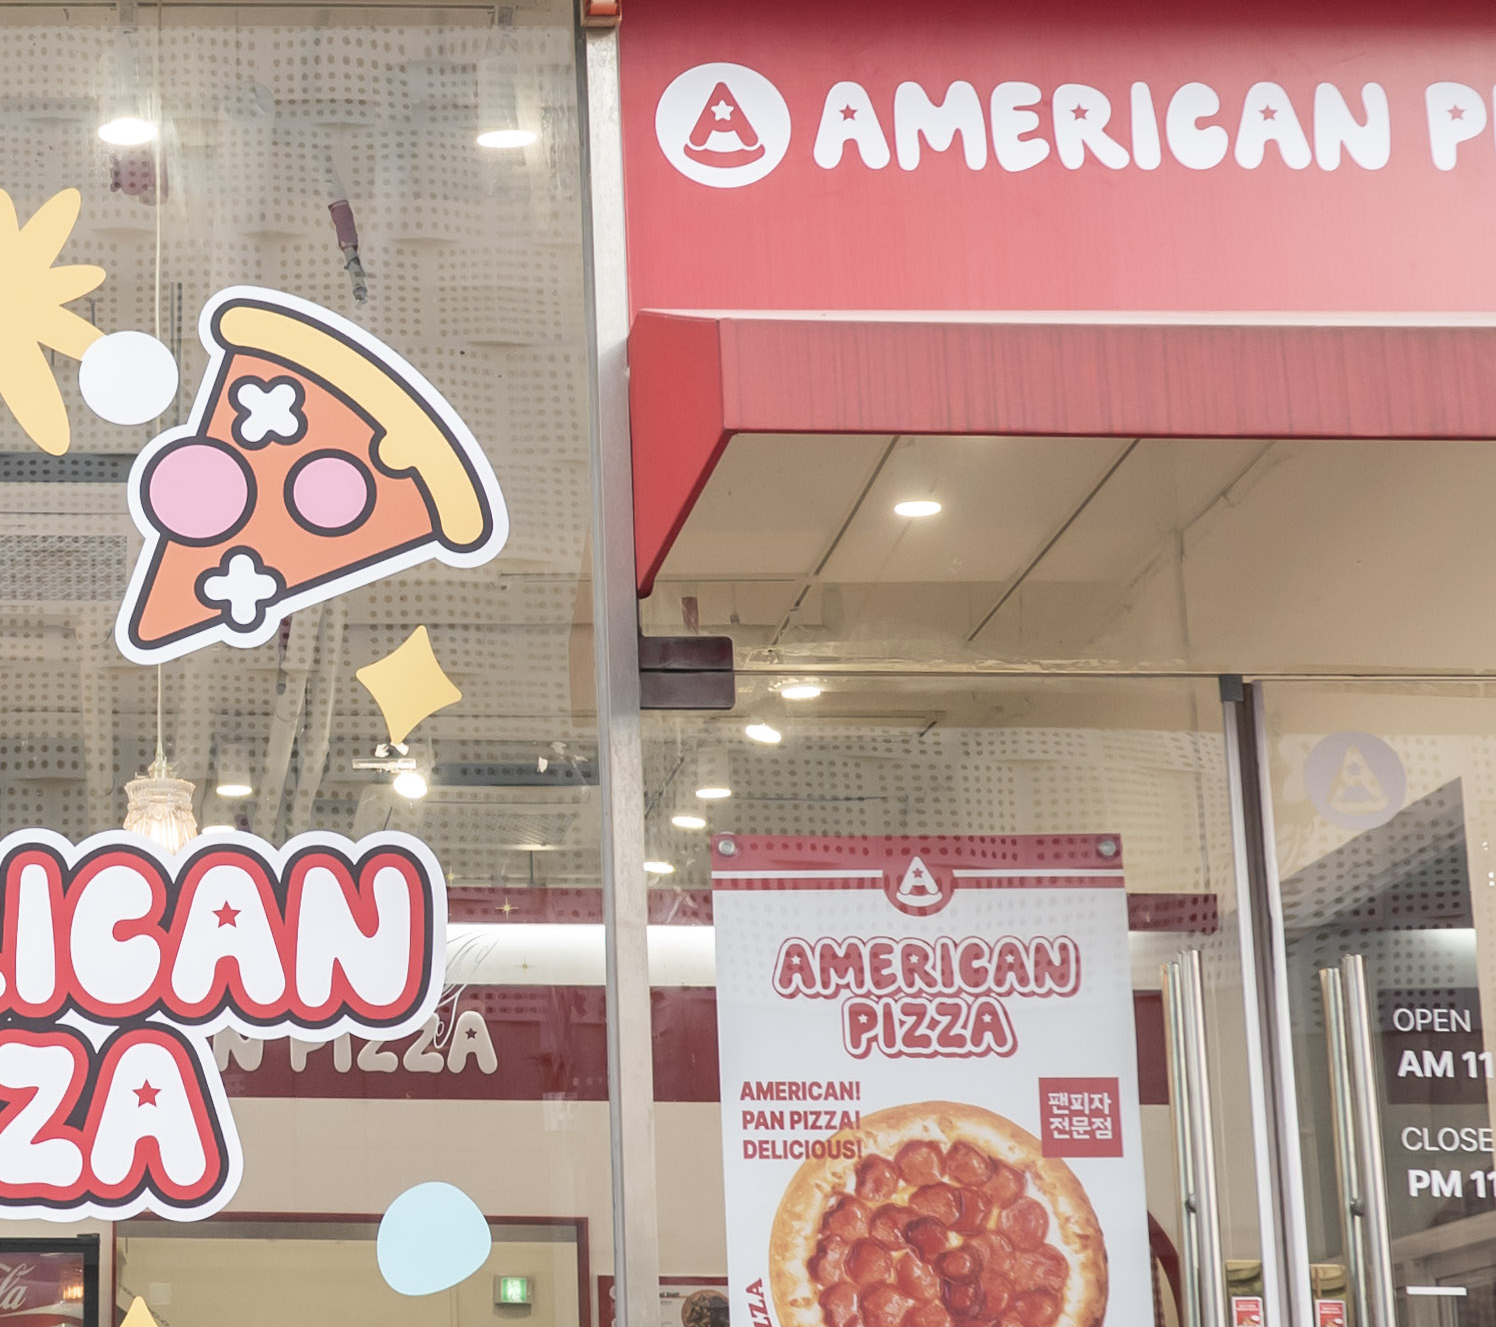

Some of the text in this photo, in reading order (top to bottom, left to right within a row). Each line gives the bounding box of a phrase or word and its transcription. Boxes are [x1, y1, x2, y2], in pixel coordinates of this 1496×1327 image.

[813, 79, 1392, 173] AMERICAN
[774, 936, 1080, 998] AMERICAN
[843, 995, 1018, 1060] PIZZA
[1393, 1008, 1471, 1032] OPEN
[1397, 1050, 1455, 1077] AM
[740, 1080, 861, 1102] AMERICAN!
[1047, 1092, 1111, 1116] 팬피자
[741, 1110, 861, 1131] PAN PIZZA!
[1048, 1117, 1113, 1140] 전문점
[742, 1139, 864, 1160] DELICIOUS!
[1401, 1127, 1496, 1152] CLOSE
[1408, 1170, 1463, 1198] PM
